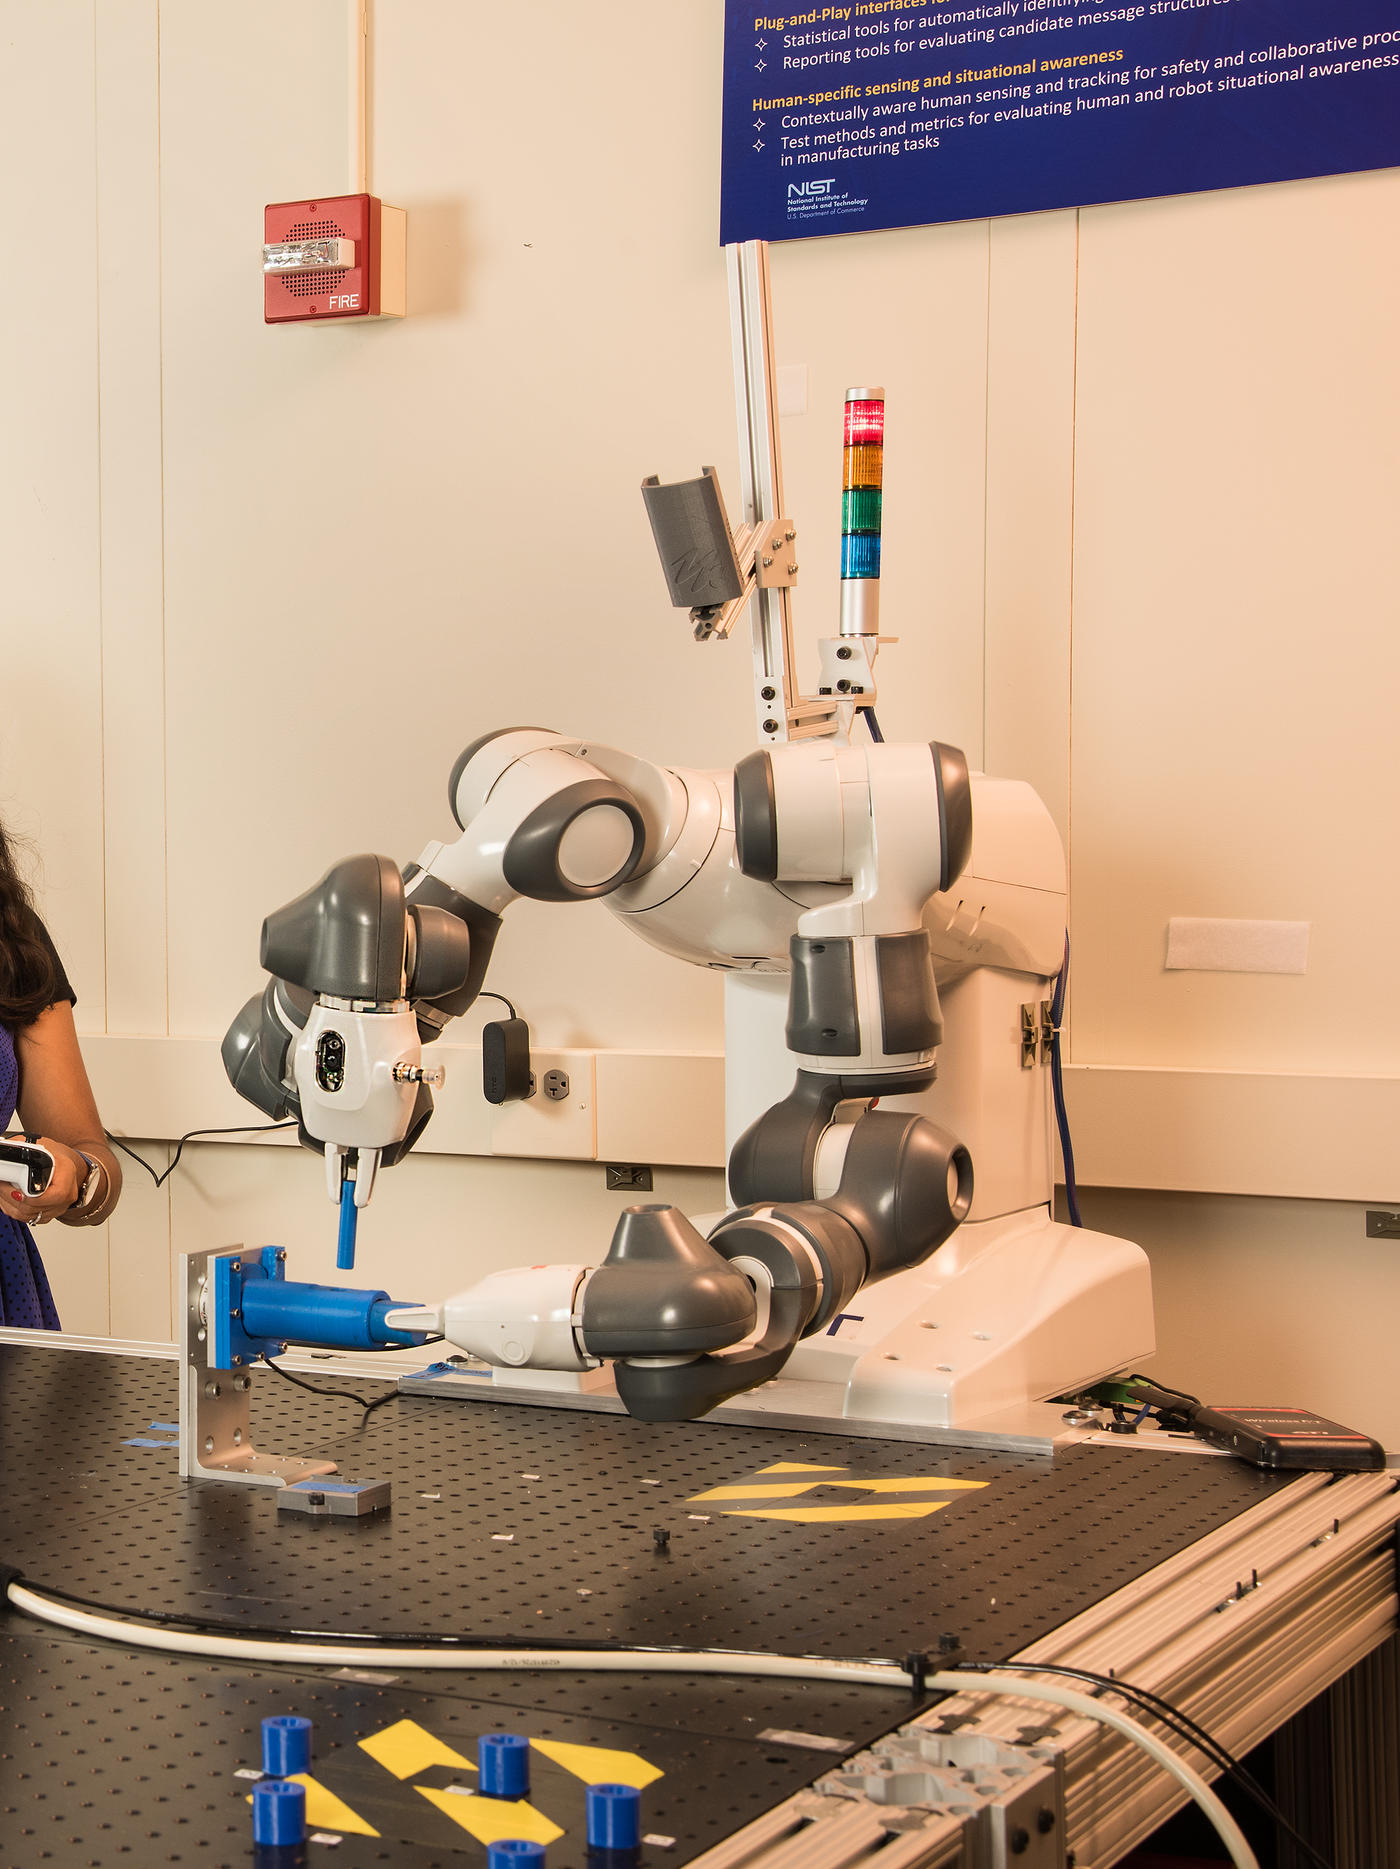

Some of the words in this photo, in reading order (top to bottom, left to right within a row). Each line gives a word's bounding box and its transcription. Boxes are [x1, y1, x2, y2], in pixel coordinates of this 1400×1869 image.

[754, 6, 852, 31] Plug-and-Play
[855, 0, 927, 16] interfaces
[783, 24, 851, 48] Statistical
[854, 20, 890, 38] tools
[893, 17, 915, 32] for
[918, 0, 1019, 28] automatically
[783, 49, 851, 70] Reporting
[854, 41, 890, 59] tools
[894, 38, 915, 53] for
[918, 28, 995, 50] evaluating
[998, 16, 1073, 38] candidate
[1078, 5, 1145, 26] message
[752, 84, 861, 111] Human-specific
[865, 78, 920, 96] sensing
[923, 70, 951, 88] and
[955, 58, 1036, 84] situational
[1040, 49, 1123, 71] awareness
[781, 104, 869, 128] Contextually
[872, 101, 916, 116] aware
[921, 93, 971, 110] human
[975, 84, 1031, 102] sensing
[1035, 76, 1063, 94] and
[1067, 70, 1130, 90] tracking
[1134, 65, 1157, 80] for
[1161, 58, 1210, 76] safety
[1214, 50, 1244, 69] and
[1248, 37, 1357, 63] collaborative
[780, 134, 810, 149] Test
[814, 125, 876, 145] methods
[879, 120, 906, 137] and
[911, 115, 964, 133] metrics
[968, 111, 990, 125] for
[994, 101, 1072, 122] evaluating
[1076, 93, 1130, 111] human
[1134, 84, 1164, 103] and
[1169, 79, 1213, 98] robot
[1217, 64, 1304, 91] situational
[1308, 54, 1400, 78] awareness
[781, 153, 793, 166] in
[797, 141, 900, 164] manufacturing
[903, 134, 939, 151] tasks
[788, 179, 835, 197] NIST
[788, 197, 814, 205] National
[788, 204, 818, 212] Standards
[834, 199, 868, 207] Technology
[329, 294, 360, 310] FIRE
